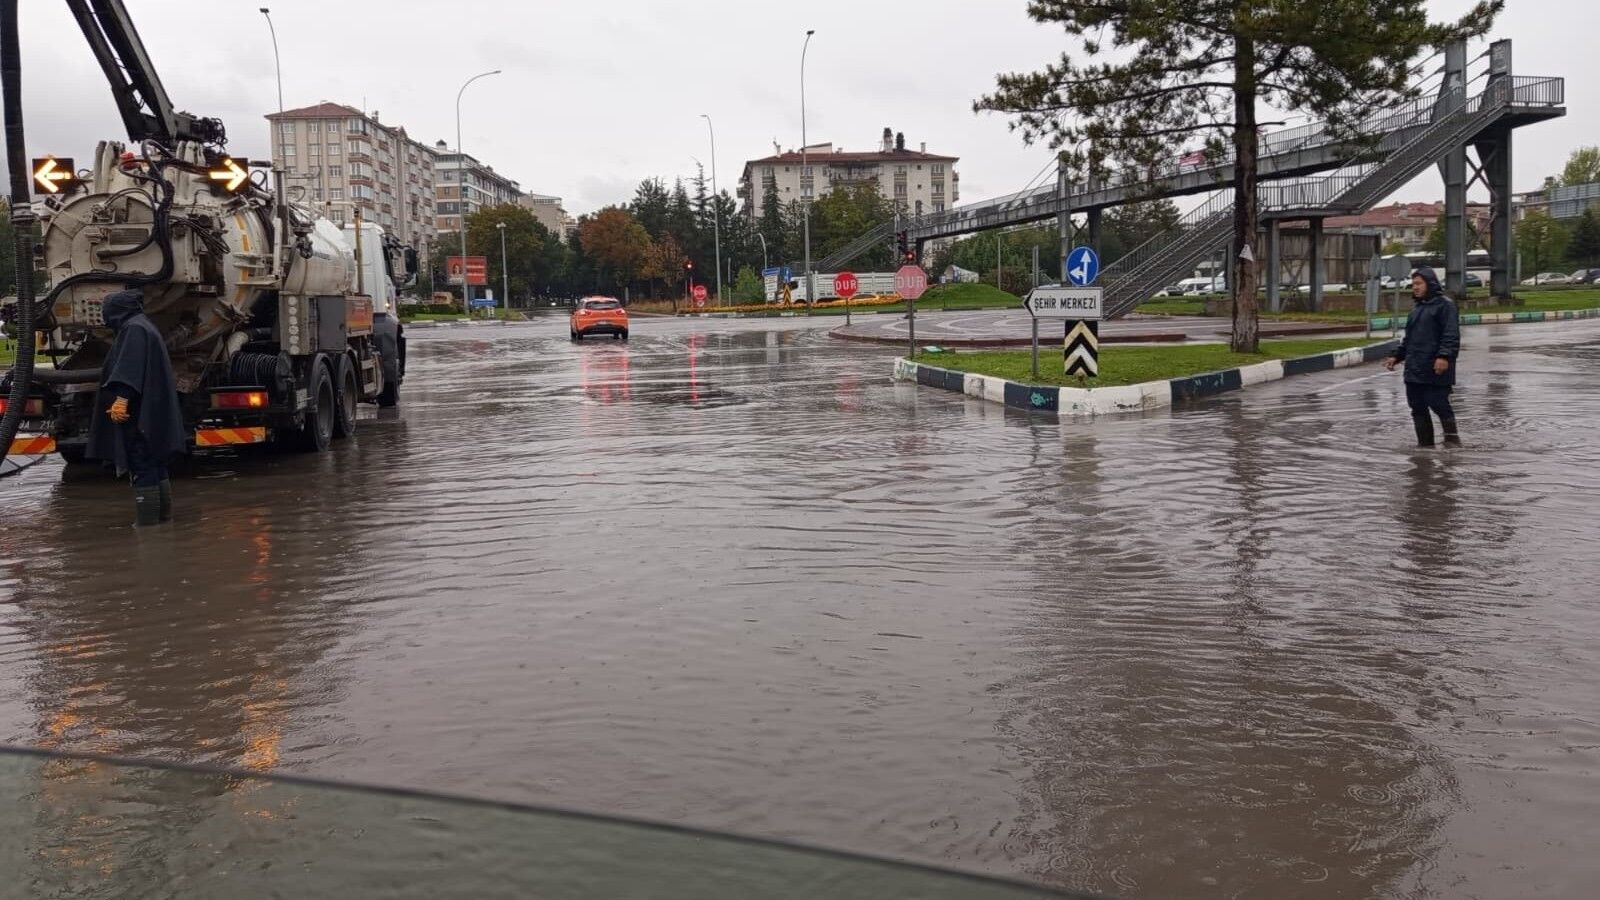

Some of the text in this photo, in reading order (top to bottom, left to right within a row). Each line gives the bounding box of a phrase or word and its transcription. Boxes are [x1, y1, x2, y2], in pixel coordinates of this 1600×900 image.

[836, 280, 857, 290] DUR
[897, 276, 924, 288] DUR
[1034, 295, 1097, 311] ŞEHİR MERKEZİ
